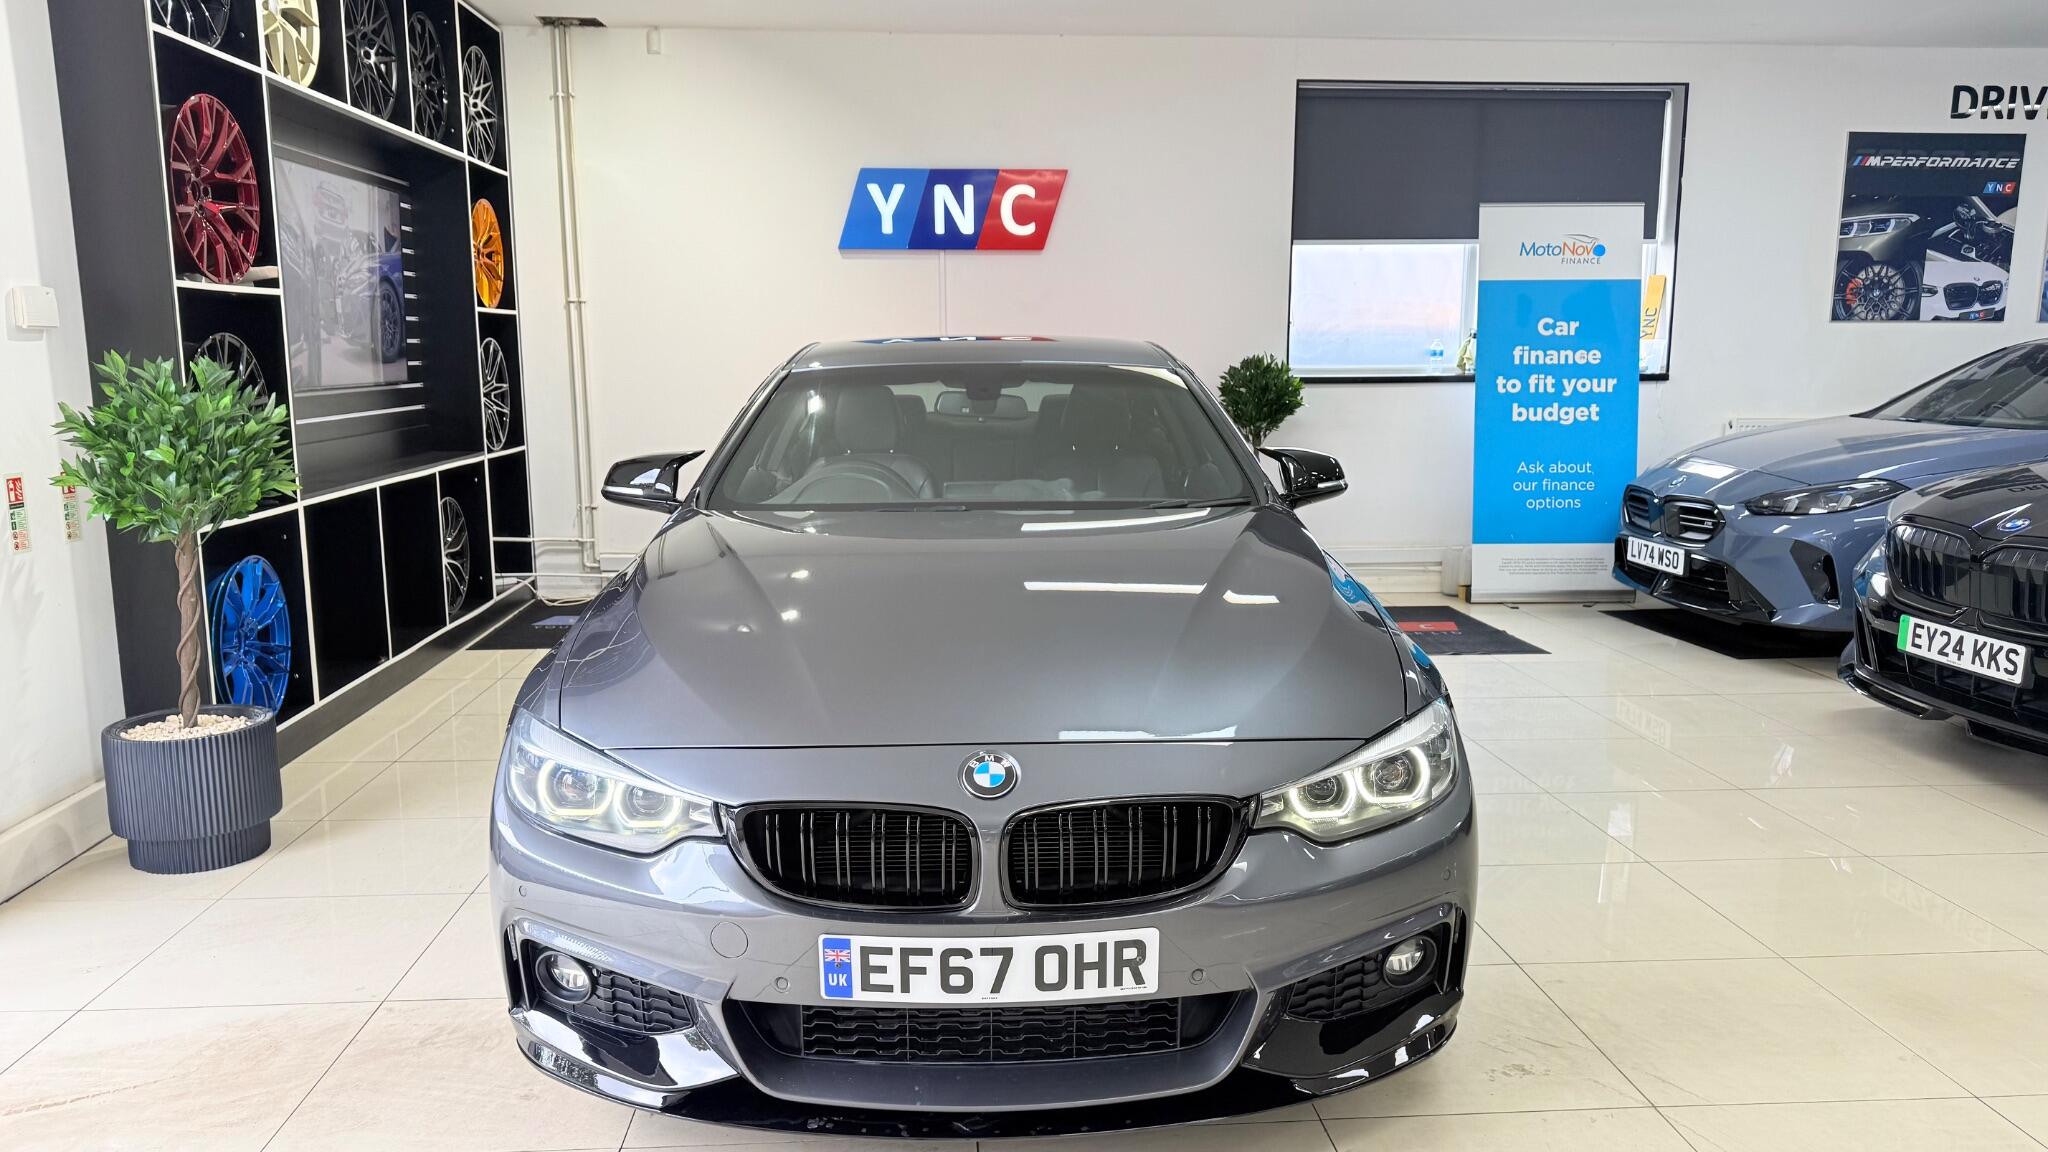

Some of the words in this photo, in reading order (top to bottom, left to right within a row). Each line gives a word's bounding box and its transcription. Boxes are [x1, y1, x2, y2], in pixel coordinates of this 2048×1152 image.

[1951, 85, 2048, 119] DRIV
[1987, 183, 2013, 192] YNC
[867, 183, 1036, 236] YNC
[1519, 241, 1605, 257] MotoNovo
[1560, 257, 1601, 265] FINANCE
[1537, 317, 1580, 336] Car
[1512, 345, 1602, 365] finance
[1496, 375, 1522, 394] to
[1528, 374, 1556, 393] fit
[1561, 377, 1617, 397] your
[1511, 402, 1600, 425] budget
[1516, 461, 1544, 474] Ask
[1548, 461, 1592, 474] about
[1513, 481, 1538, 492] our
[1542, 478, 1595, 492] finance
[1526, 496, 1582, 511] options
[1630, 539, 1655, 564] LV74
[1910, 623, 1965, 662] EY24
[1970, 638, 2020, 677] KKS
[969, 755, 1011, 768] BMW
[859, 945, 1014, 995] EF67
[1034, 938, 1148, 993] OHR
[828, 973, 848, 988] UK
